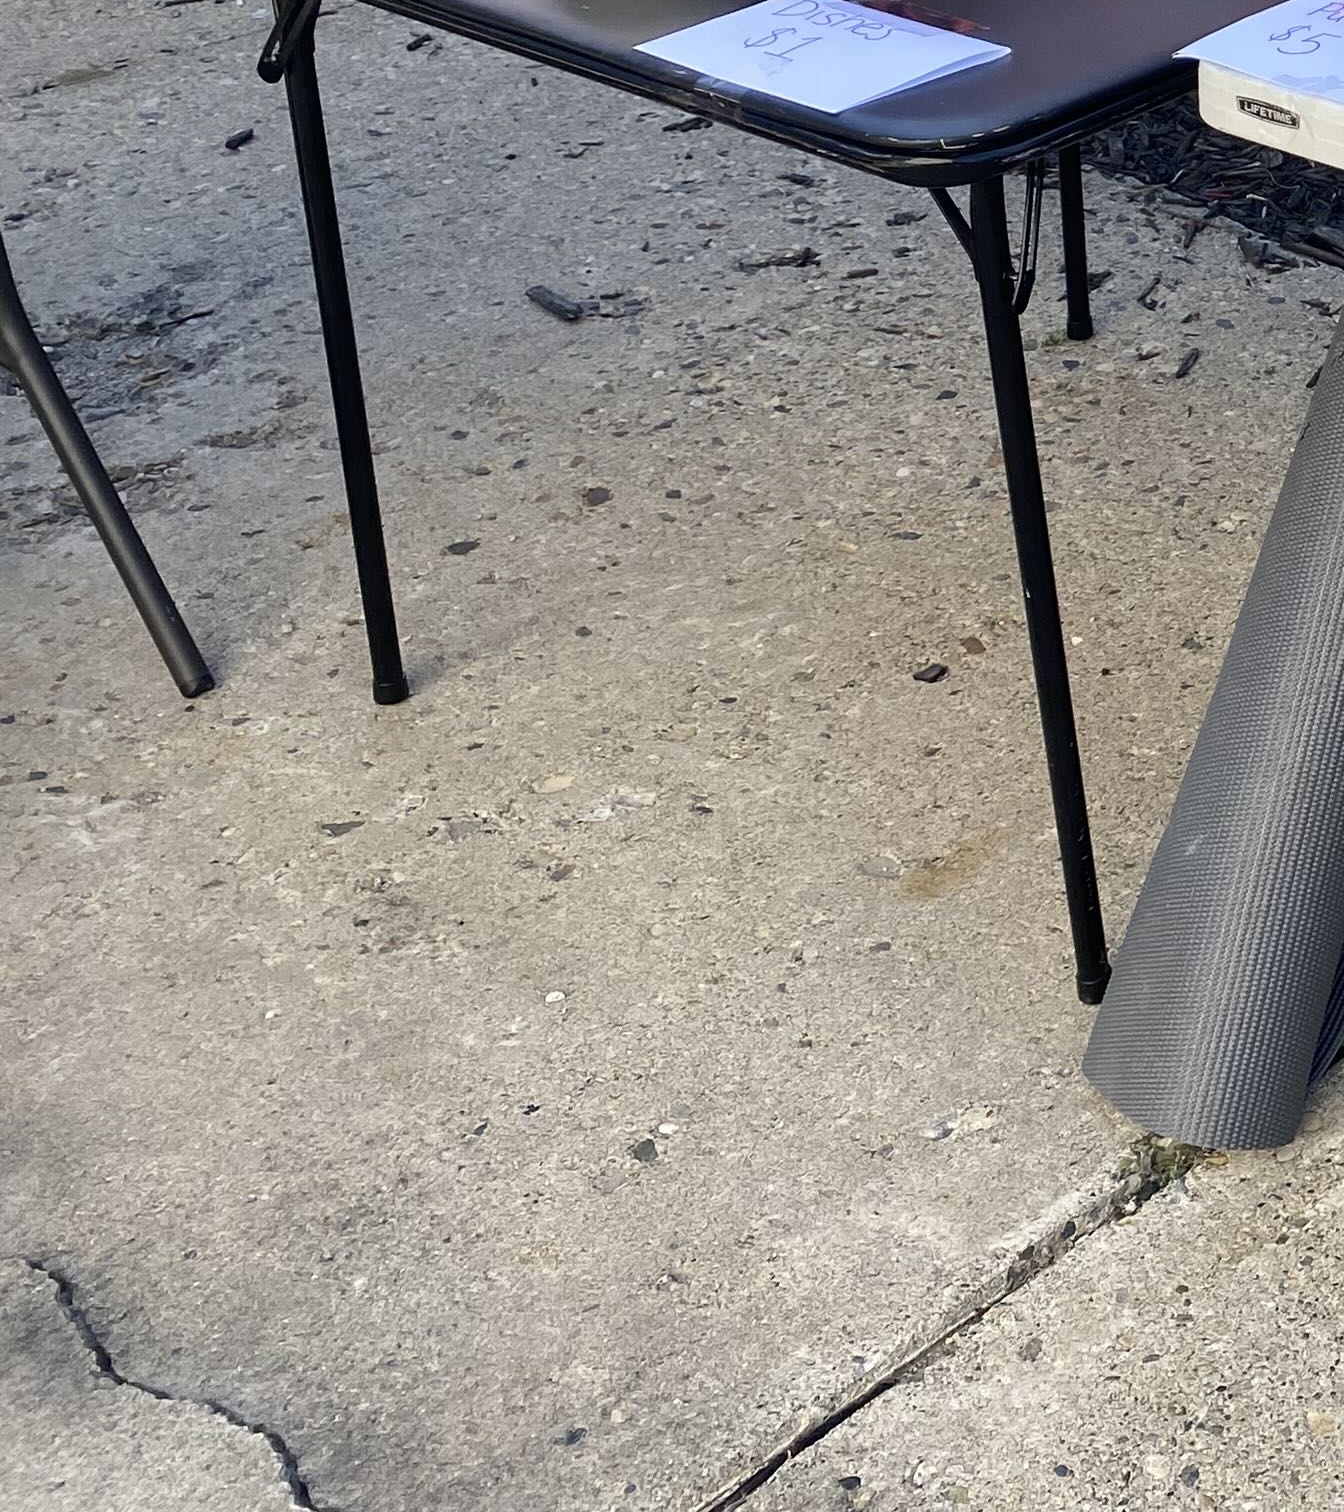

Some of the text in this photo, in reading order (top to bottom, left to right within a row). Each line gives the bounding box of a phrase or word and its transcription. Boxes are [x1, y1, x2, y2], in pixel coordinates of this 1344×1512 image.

[743, 26, 824, 62] $1
[1268, 24, 1342, 55] $5
[1244, 100, 1294, 125] LIFETIME
